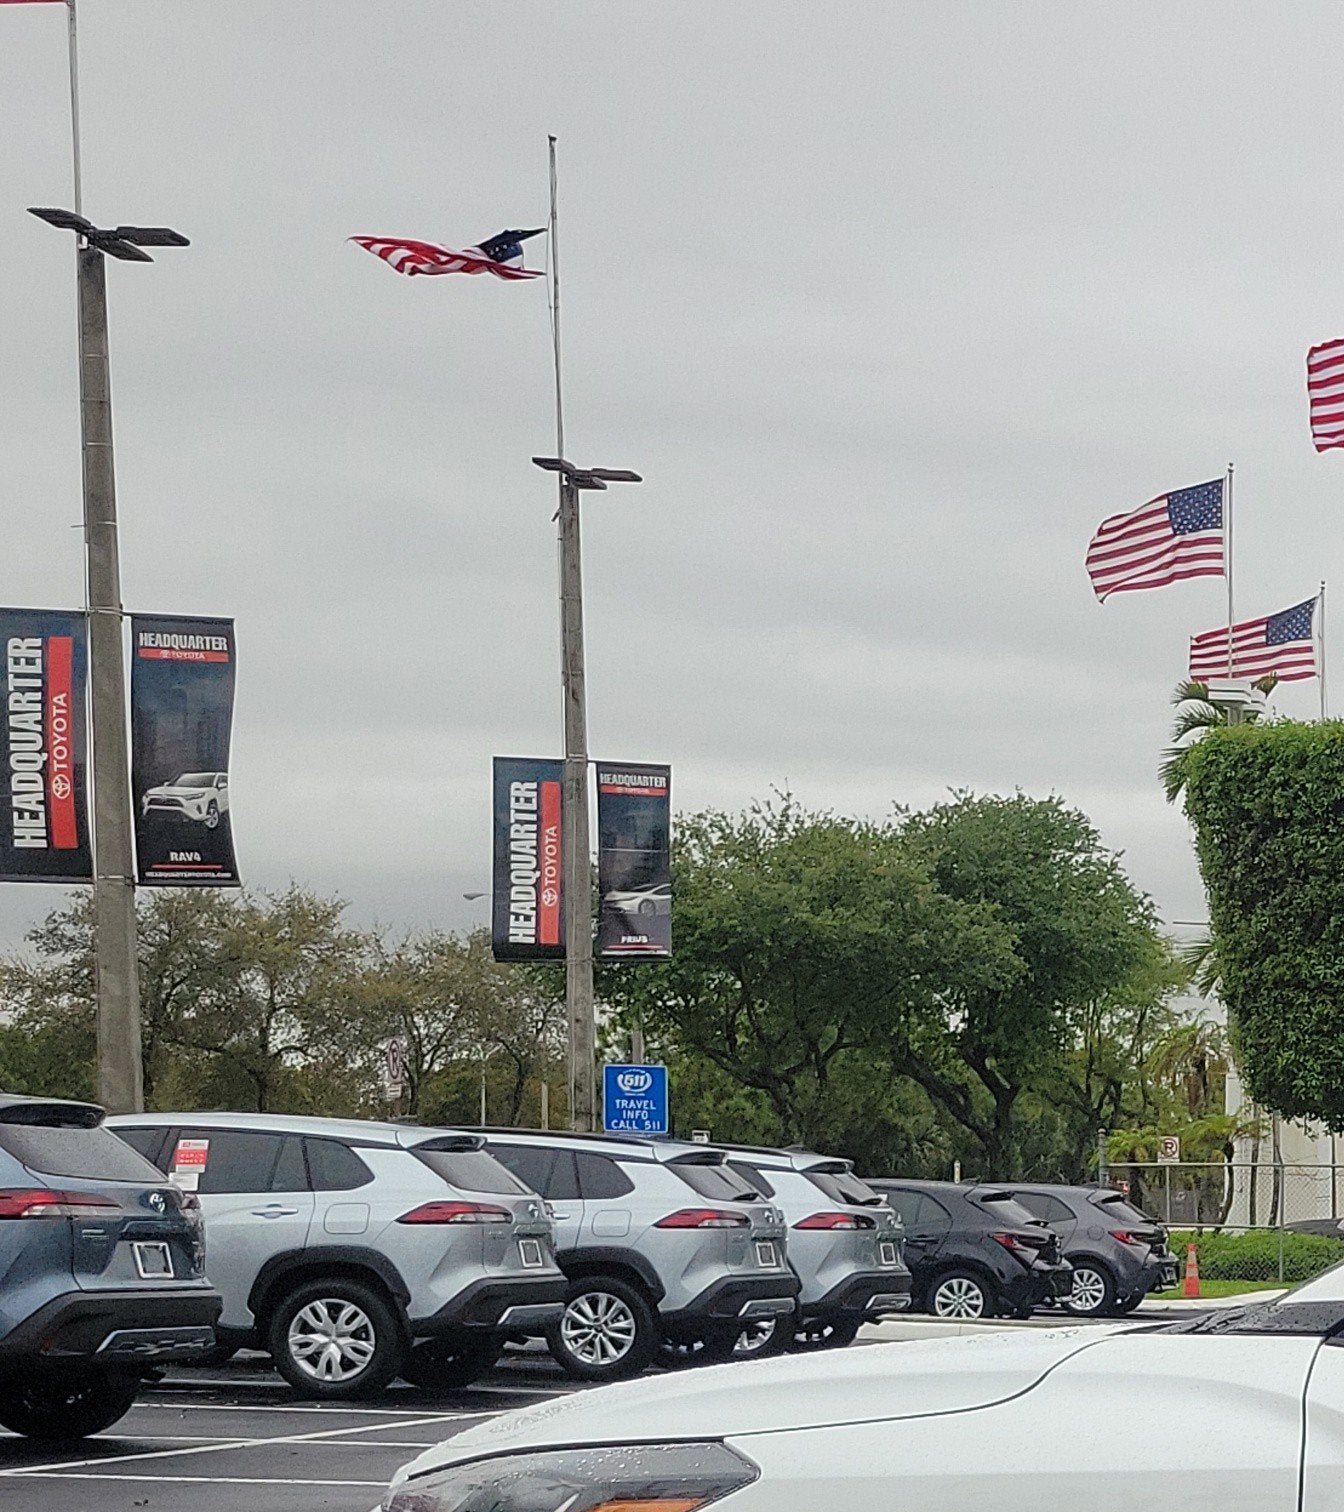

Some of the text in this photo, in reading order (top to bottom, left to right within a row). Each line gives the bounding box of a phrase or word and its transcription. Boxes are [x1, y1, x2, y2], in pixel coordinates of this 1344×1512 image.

[139, 632, 228, 651] HEADQUARTER
[53, 692, 67, 771] TOYOTA
[7, 637, 48, 848] HEADQUARTER
[169, 851, 202, 862] RAV4
[509, 781, 541, 944] HEADQUARTER
[545, 825, 557, 886] TOYOTA
[623, 1074, 645, 1087] 511
[615, 1099, 656, 1110] TRAVEL
[622, 1110, 648, 1120] INFO
[611, 1119, 660, 1130] CALL 511
